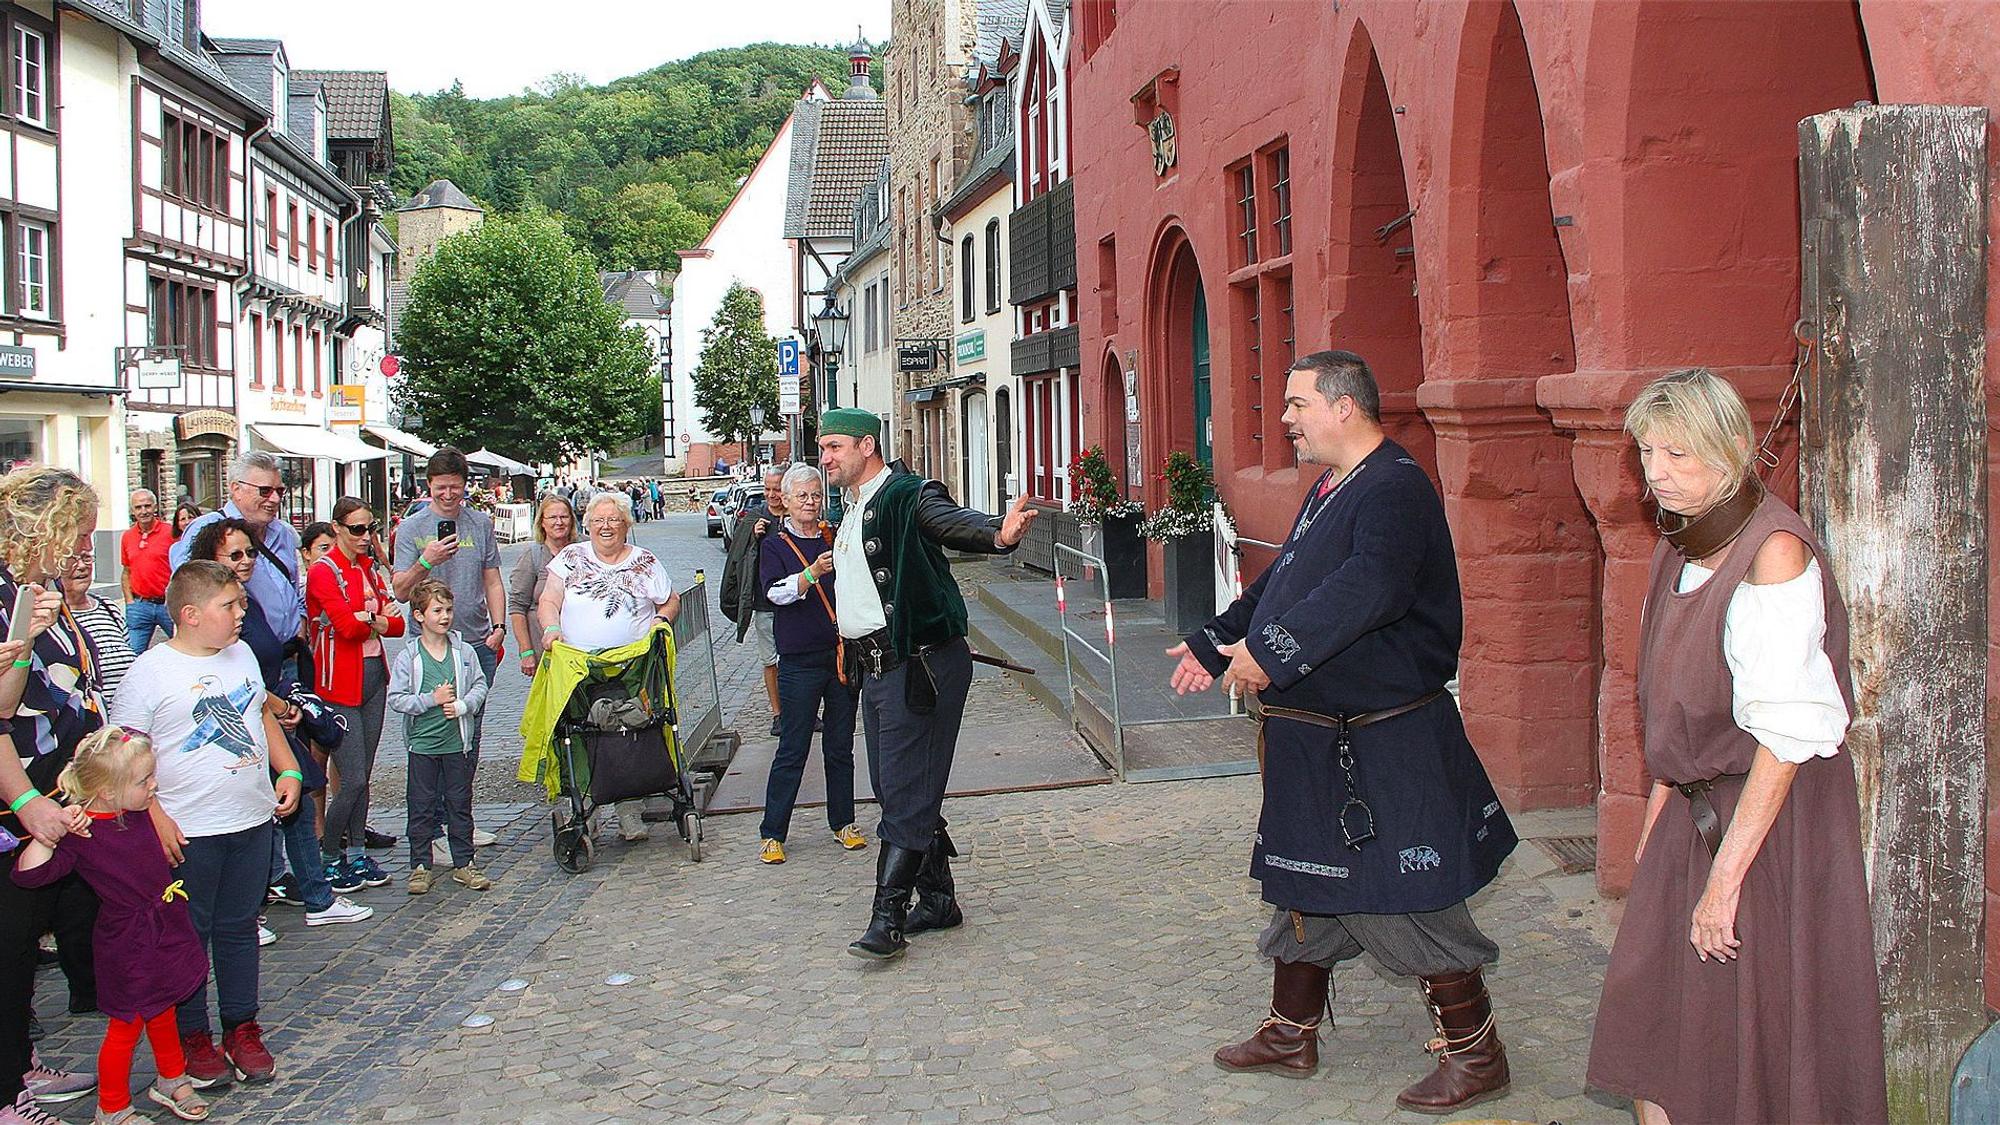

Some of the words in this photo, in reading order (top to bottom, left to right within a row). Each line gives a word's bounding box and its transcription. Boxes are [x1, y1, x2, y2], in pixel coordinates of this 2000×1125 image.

[0, 352, 34, 369] WEBER
[782, 345, 794, 373] P
[901, 356, 929, 366] ESPRIT
